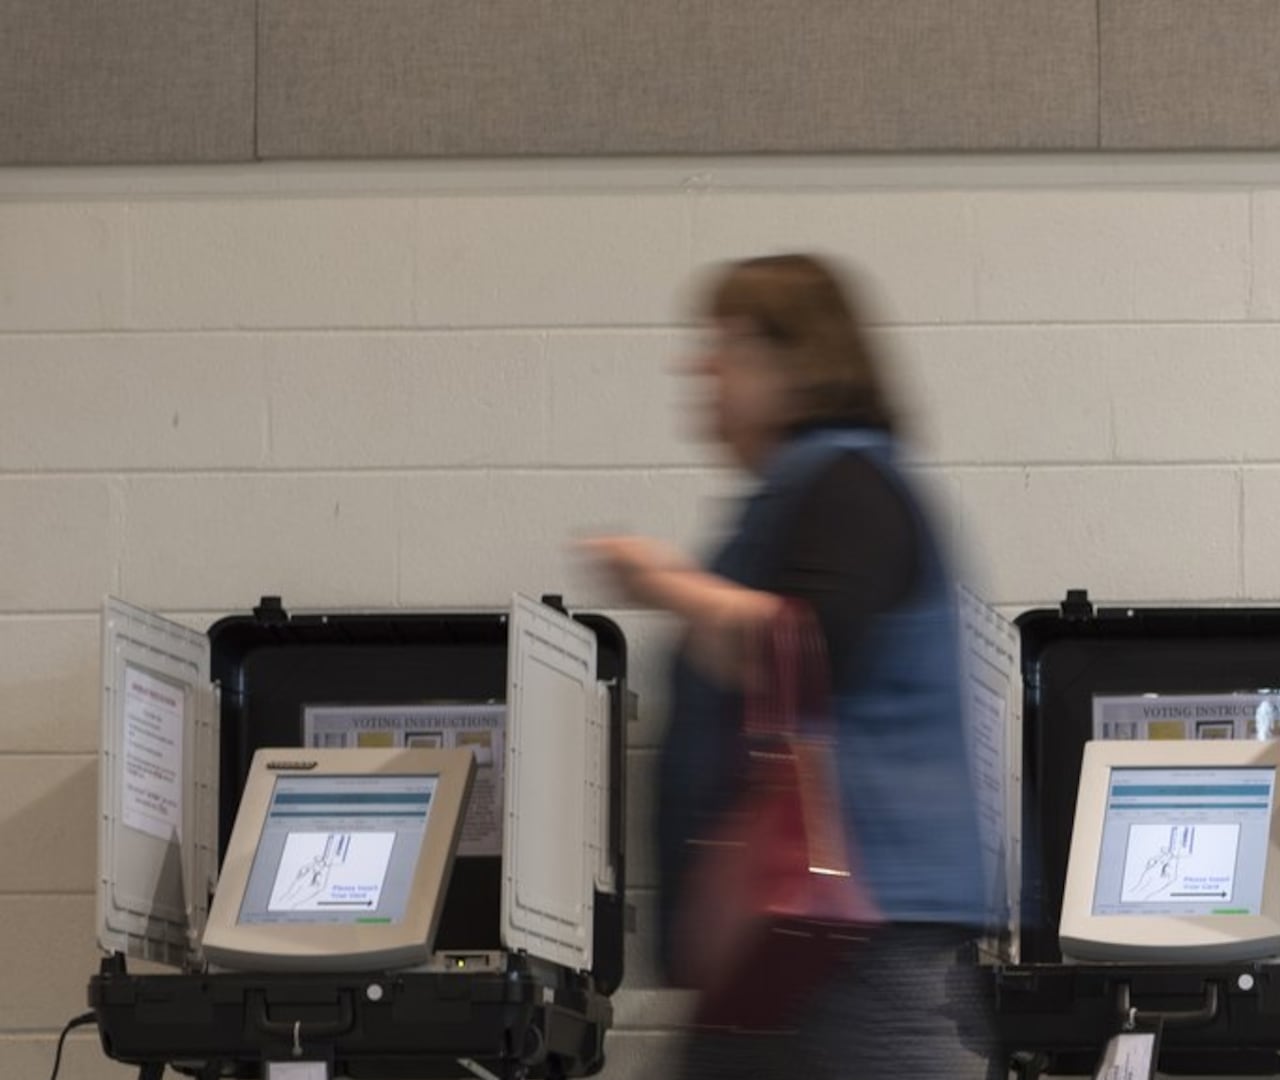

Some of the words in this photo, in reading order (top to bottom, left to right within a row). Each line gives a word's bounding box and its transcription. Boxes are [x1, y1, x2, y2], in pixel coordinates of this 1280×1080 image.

[1143, 707, 1192, 718] VOTING
[353, 717, 400, 729] VOTING
[404, 716, 499, 729] INSTRUCTIONS
